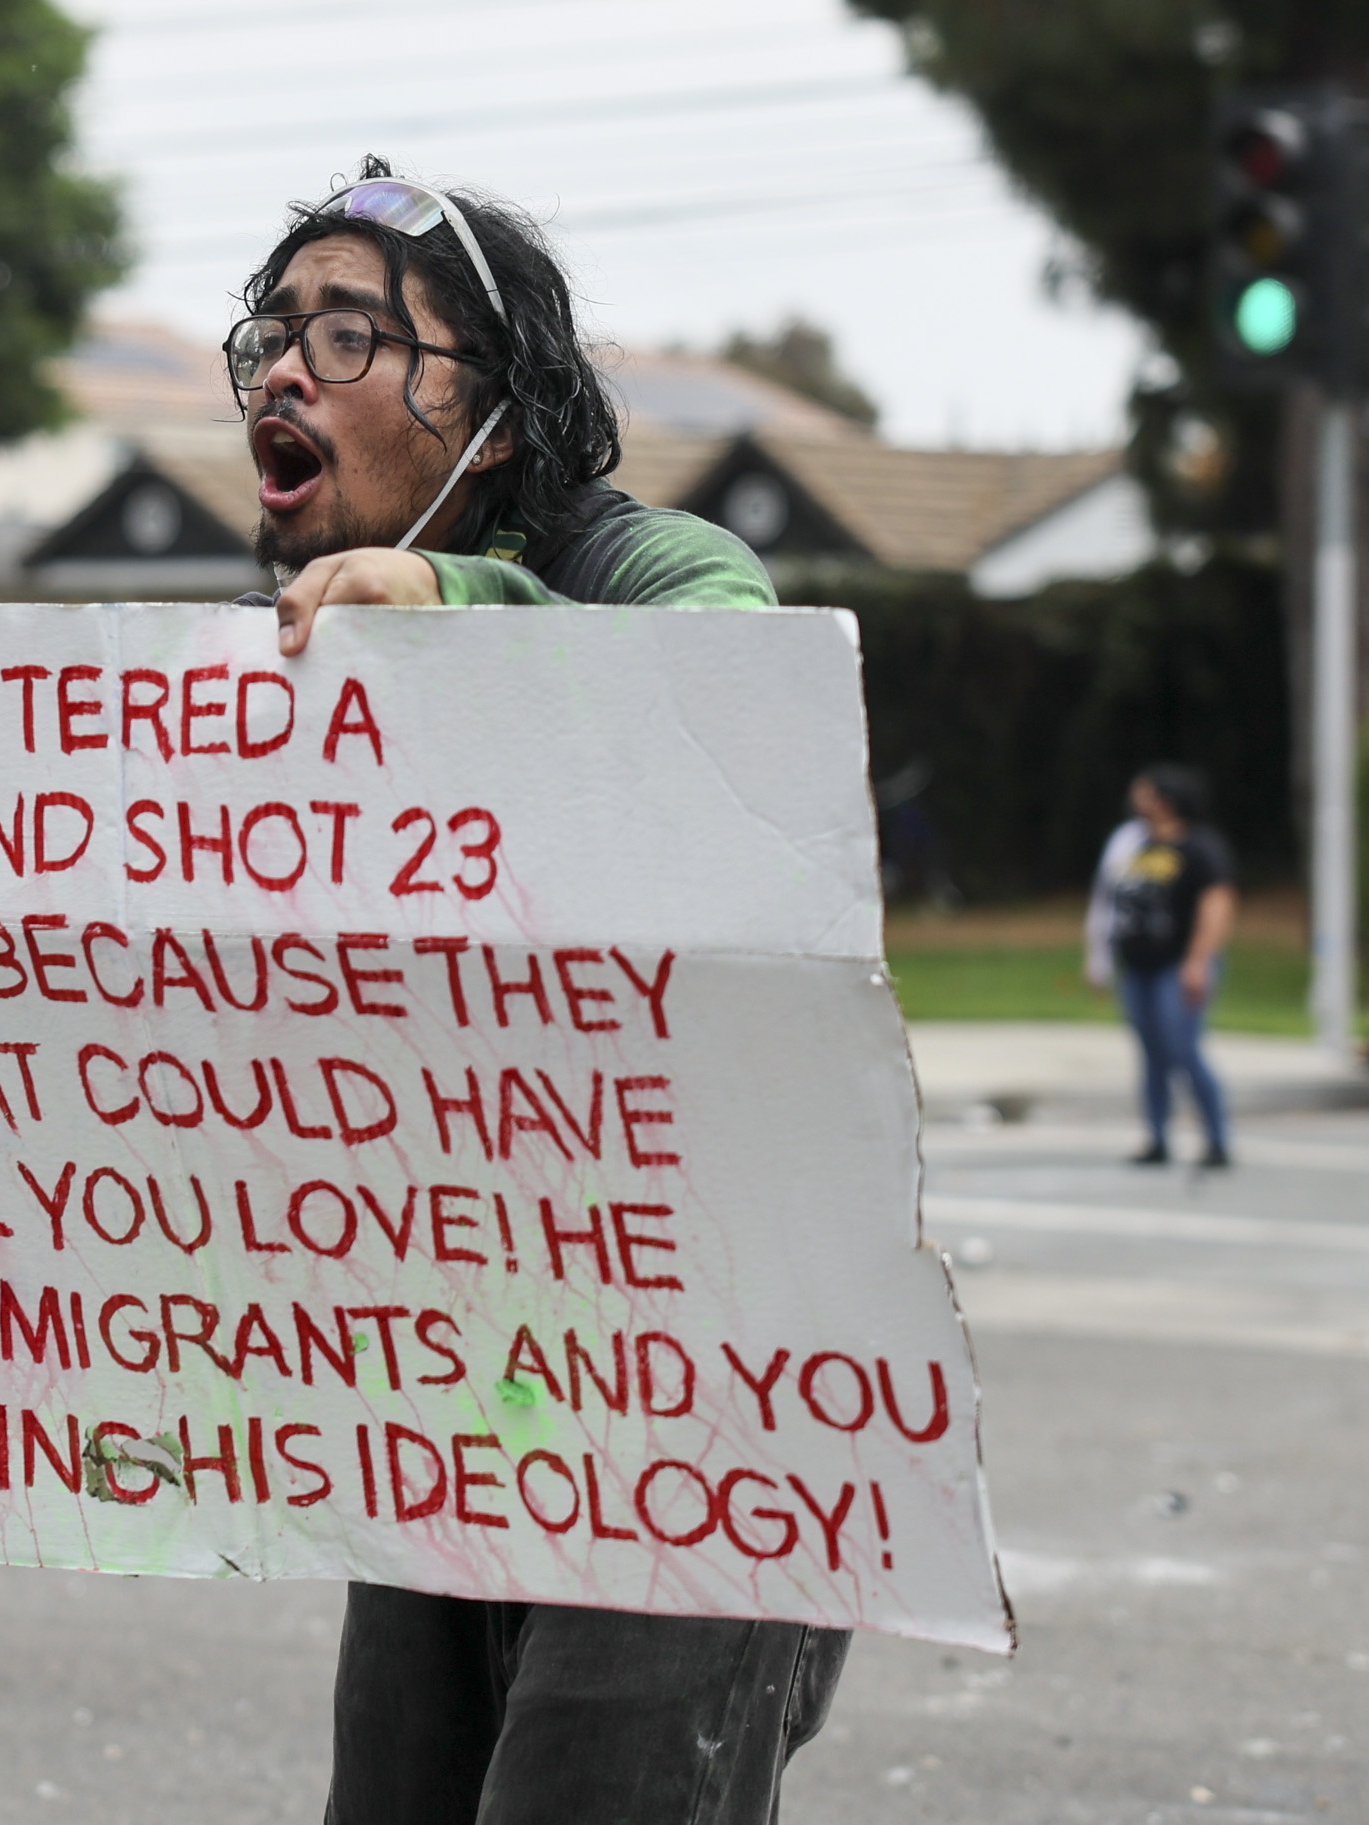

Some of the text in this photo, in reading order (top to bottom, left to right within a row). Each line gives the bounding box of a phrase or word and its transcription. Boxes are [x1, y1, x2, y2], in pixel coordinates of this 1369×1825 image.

[321, 676, 384, 767] A
[123, 799, 363, 891] SHOT
[388, 807, 502, 901] 23
[412, 935, 676, 1040] THEY
[77, 1042, 399, 1146] COULD
[421, 1065, 683, 1168] HAVE
[17, 1160, 211, 1255] YOU
[234, 1178, 519, 1274] LOVE!
[540, 1195, 685, 1292] HE
[0, 1278, 467, 1386] MIGRANTS
[503, 1323, 695, 1418] AND
[722, 1340, 950, 1445] YOU
[178, 1414, 333, 1509] HIS
[356, 1421, 894, 1574] IDEOLOGY!
